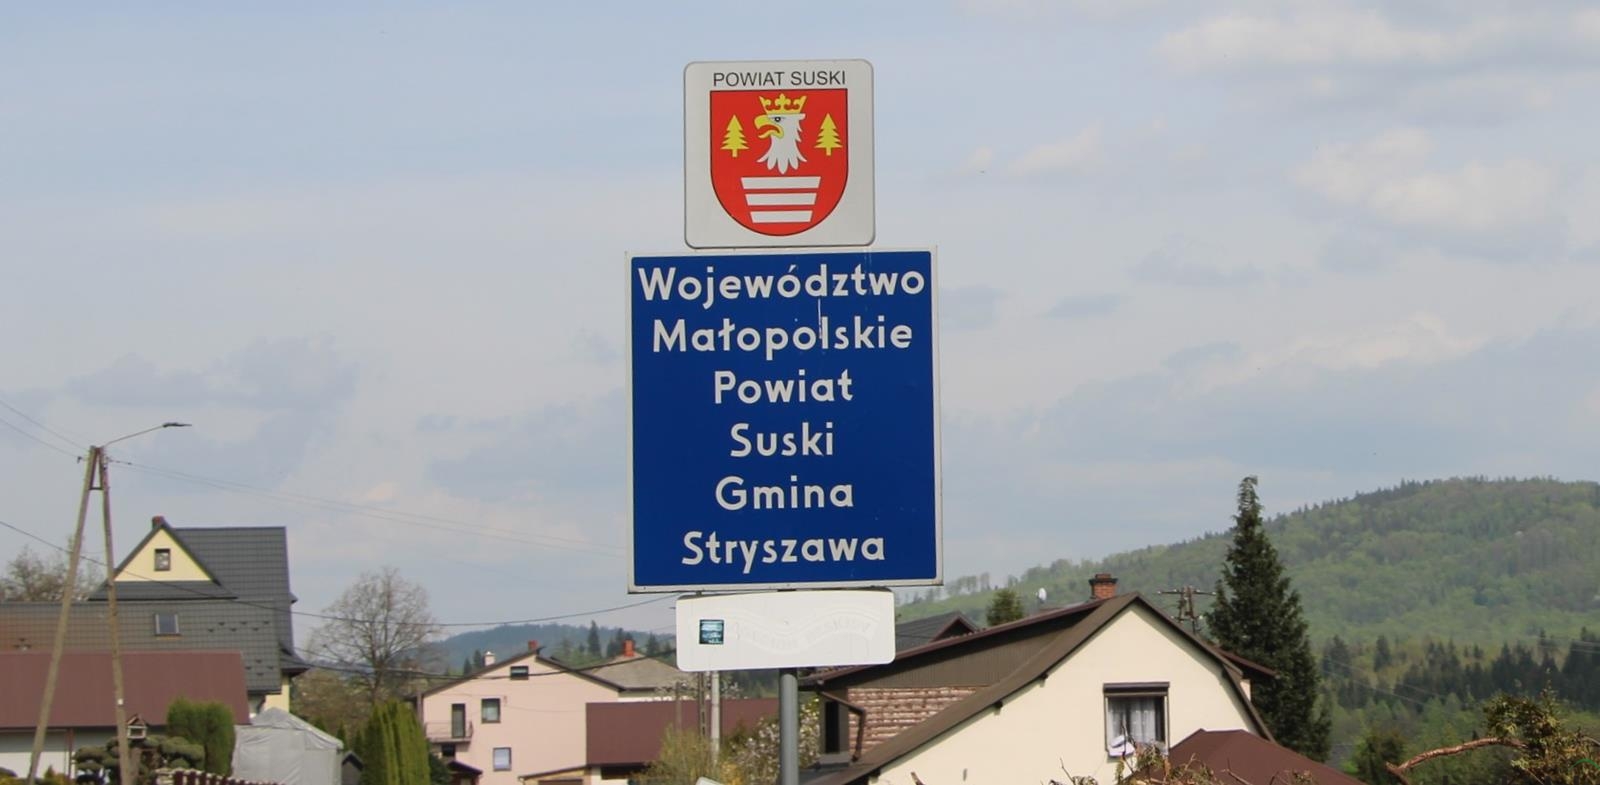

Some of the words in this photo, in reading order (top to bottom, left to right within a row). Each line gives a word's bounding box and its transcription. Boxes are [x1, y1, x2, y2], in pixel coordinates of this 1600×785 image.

[712, 71, 786, 87] POWIAT
[790, 70, 846, 86] SUSKI
[637, 263, 925, 309] Województwo
[652, 315, 913, 361] Małopolskie
[714, 369, 854, 404] Powiat
[730, 421, 834, 457] Suski
[715, 475, 854, 511] Gmina
[681, 530, 886, 574] Stryszawa
